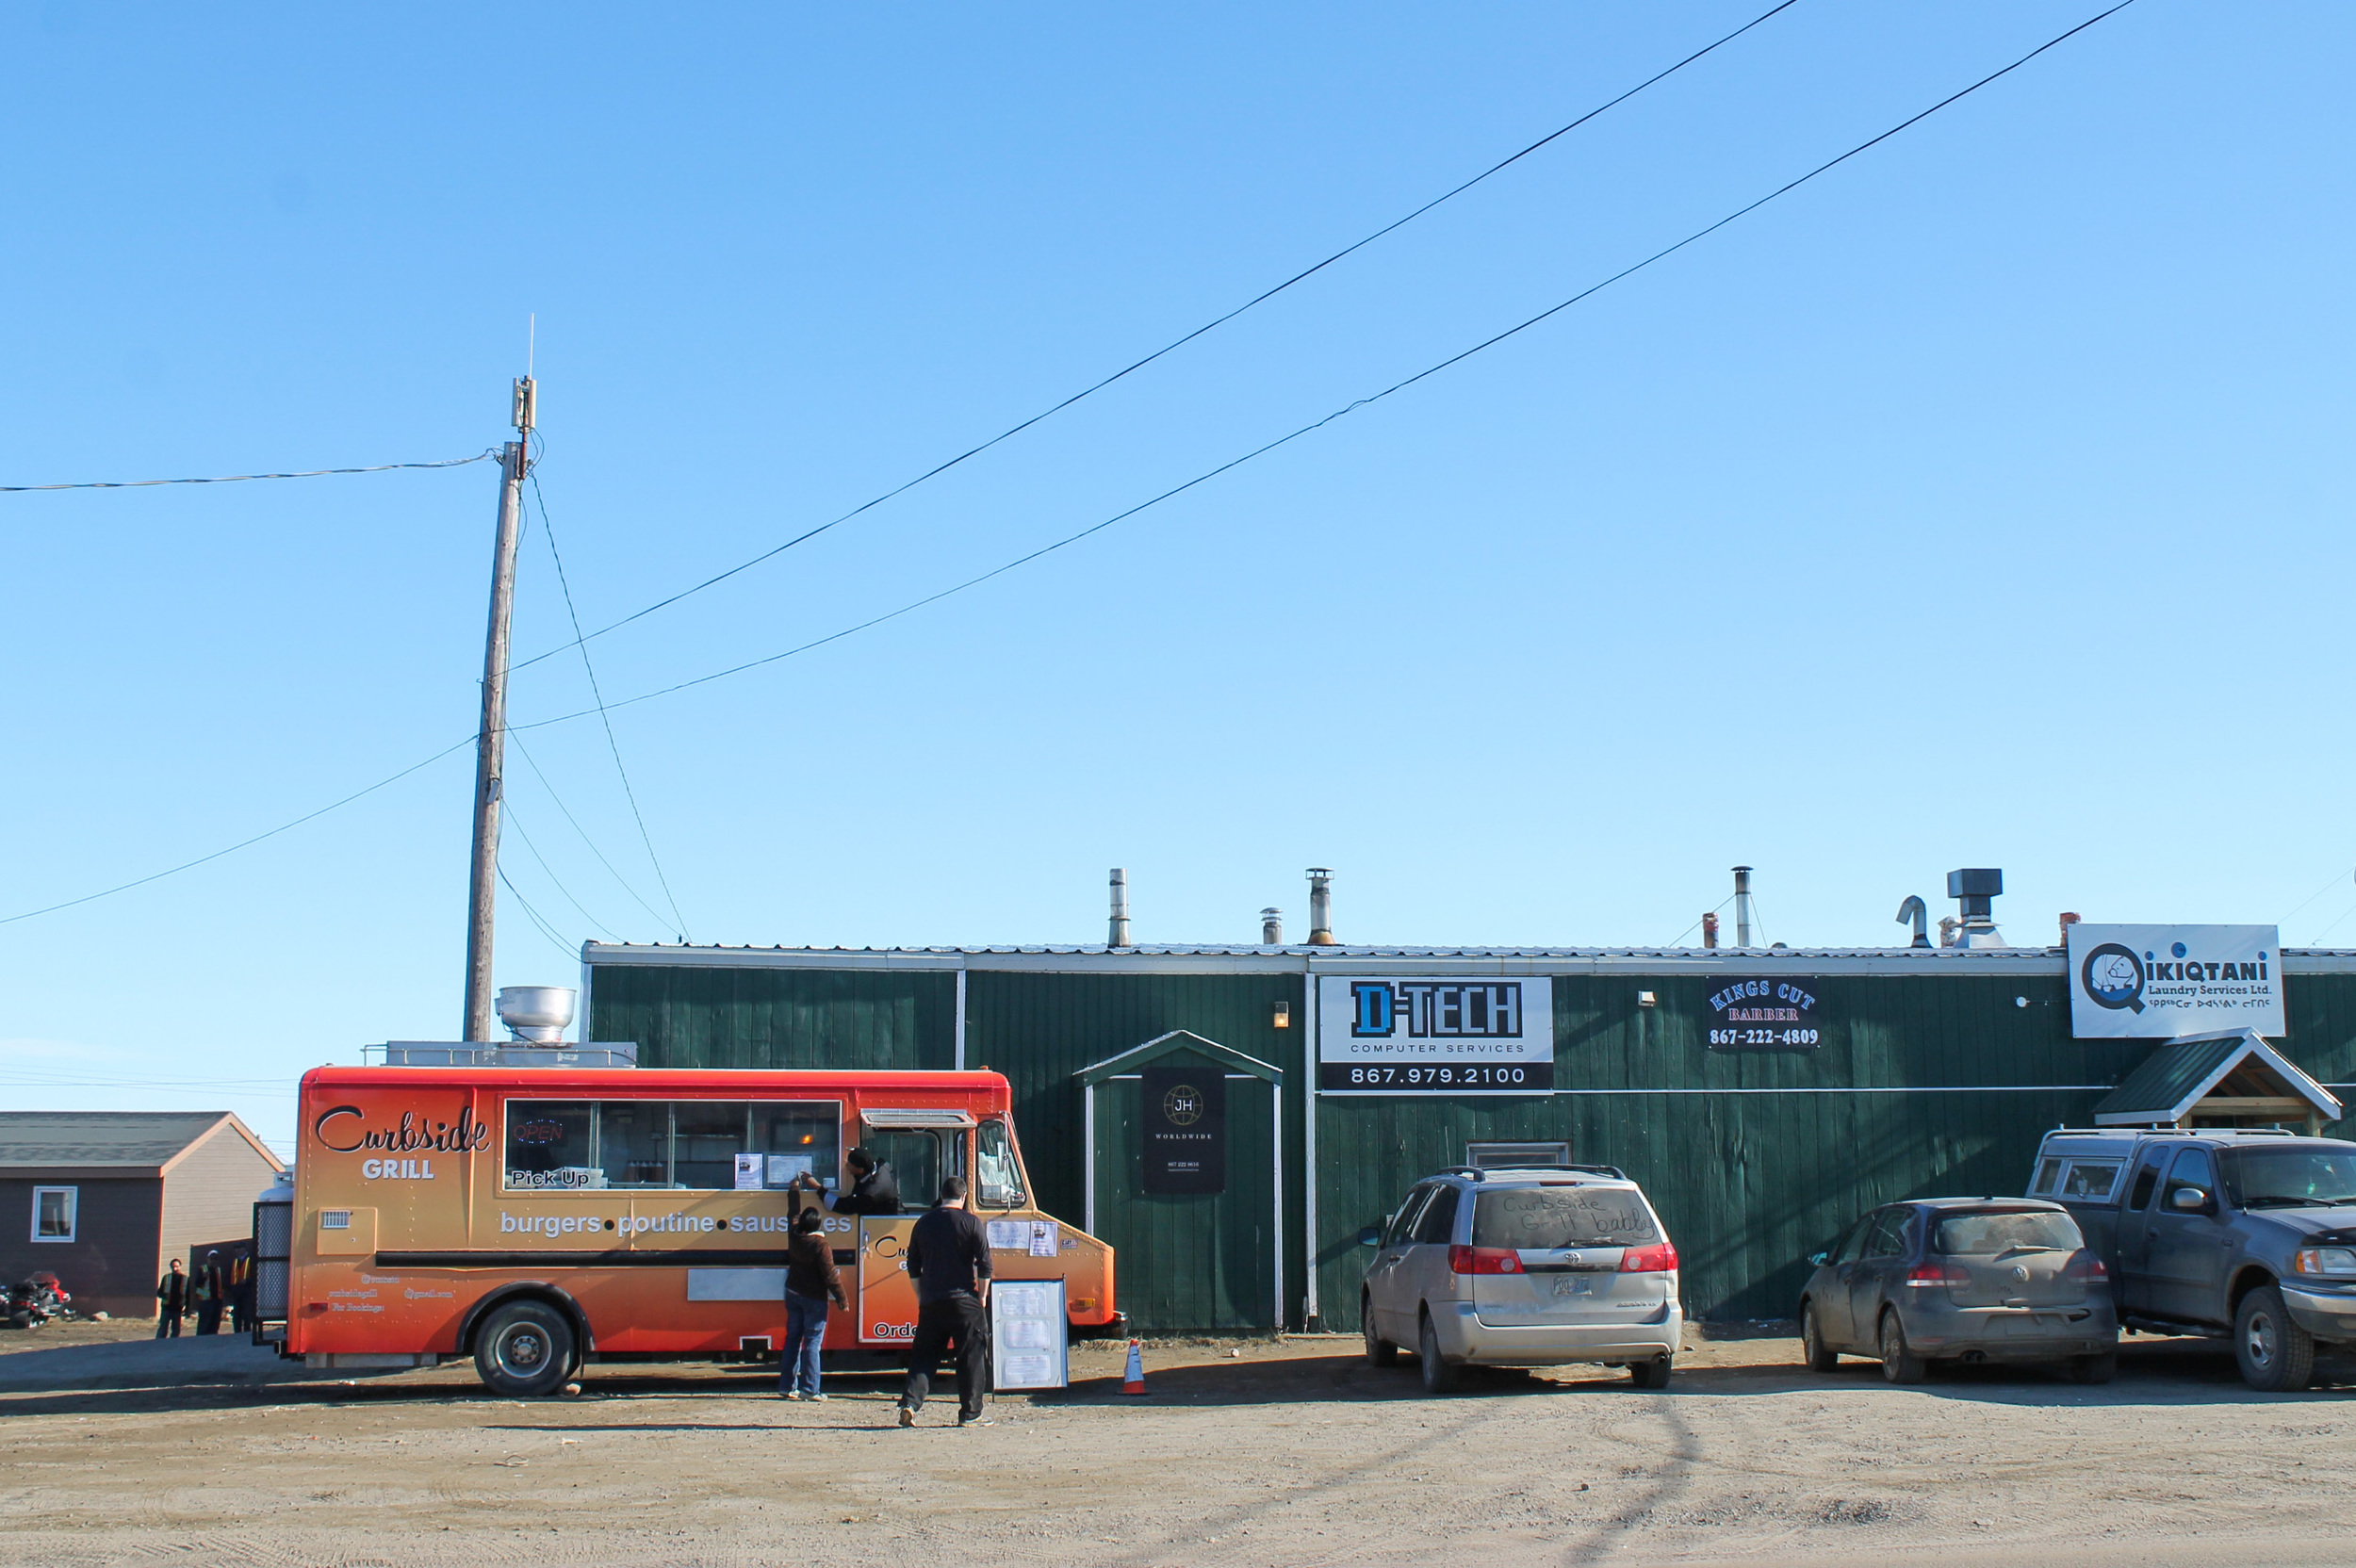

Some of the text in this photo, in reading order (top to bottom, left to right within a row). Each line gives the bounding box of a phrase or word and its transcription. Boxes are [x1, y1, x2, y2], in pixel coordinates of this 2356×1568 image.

[1710, 980, 1816, 1012] KINGS CUT
[2148, 986, 2272, 997] Laundry Services Ltd.
[1351, 982, 1523, 1037] D-TECH
[1728, 1007, 1799, 1021] BARBER
[1710, 1029, 1819, 1045] 867-222-4809
[1350, 1044, 1525, 1054] COMPUTER SERVICES
[1350, 1068, 1525, 1084] 867.979.2100
[1174, 1099, 1193, 1112] JH
[316, 1105, 491, 1152] Curbside
[513, 1124, 564, 1140] OPEN
[362, 1158, 435, 1180] GRILL
[512, 1170, 591, 1188] Pick Up
[1503, 1195, 1606, 1213] Curbside
[500, 1212, 852, 1238] burgers poutine sauses
